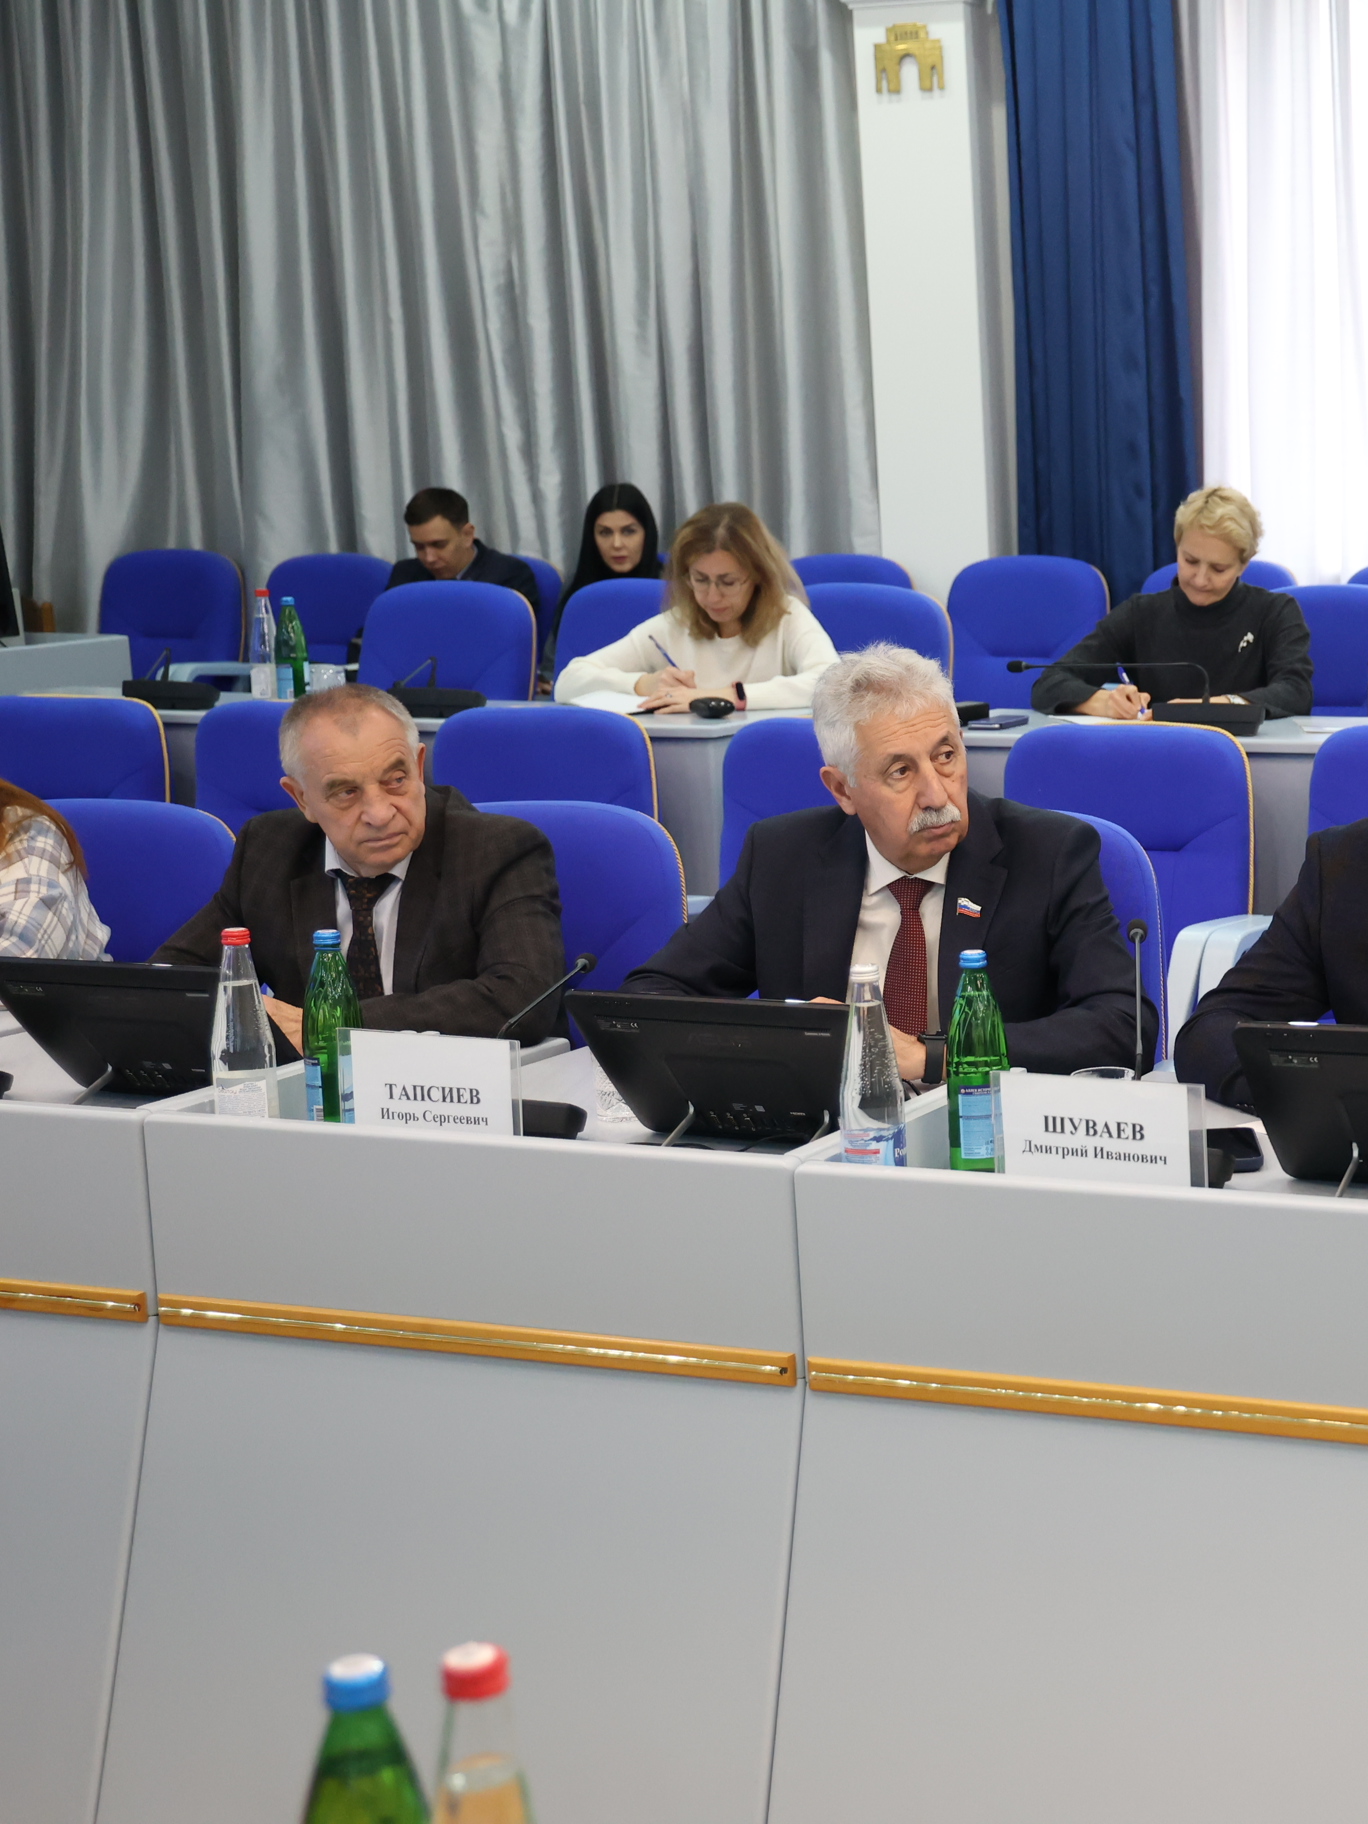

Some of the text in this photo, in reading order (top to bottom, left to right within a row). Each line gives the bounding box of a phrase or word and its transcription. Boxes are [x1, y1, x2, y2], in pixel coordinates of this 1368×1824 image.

[384, 1083, 481, 1104] ТАПСИЕВ
[380, 1107, 488, 1126] Игорь Сергеевич
[1043, 1115, 1145, 1141] ШУВАЕВ
[1022, 1139, 1088, 1159] Дмитрий
[1093, 1146, 1168, 1165] Иванович
